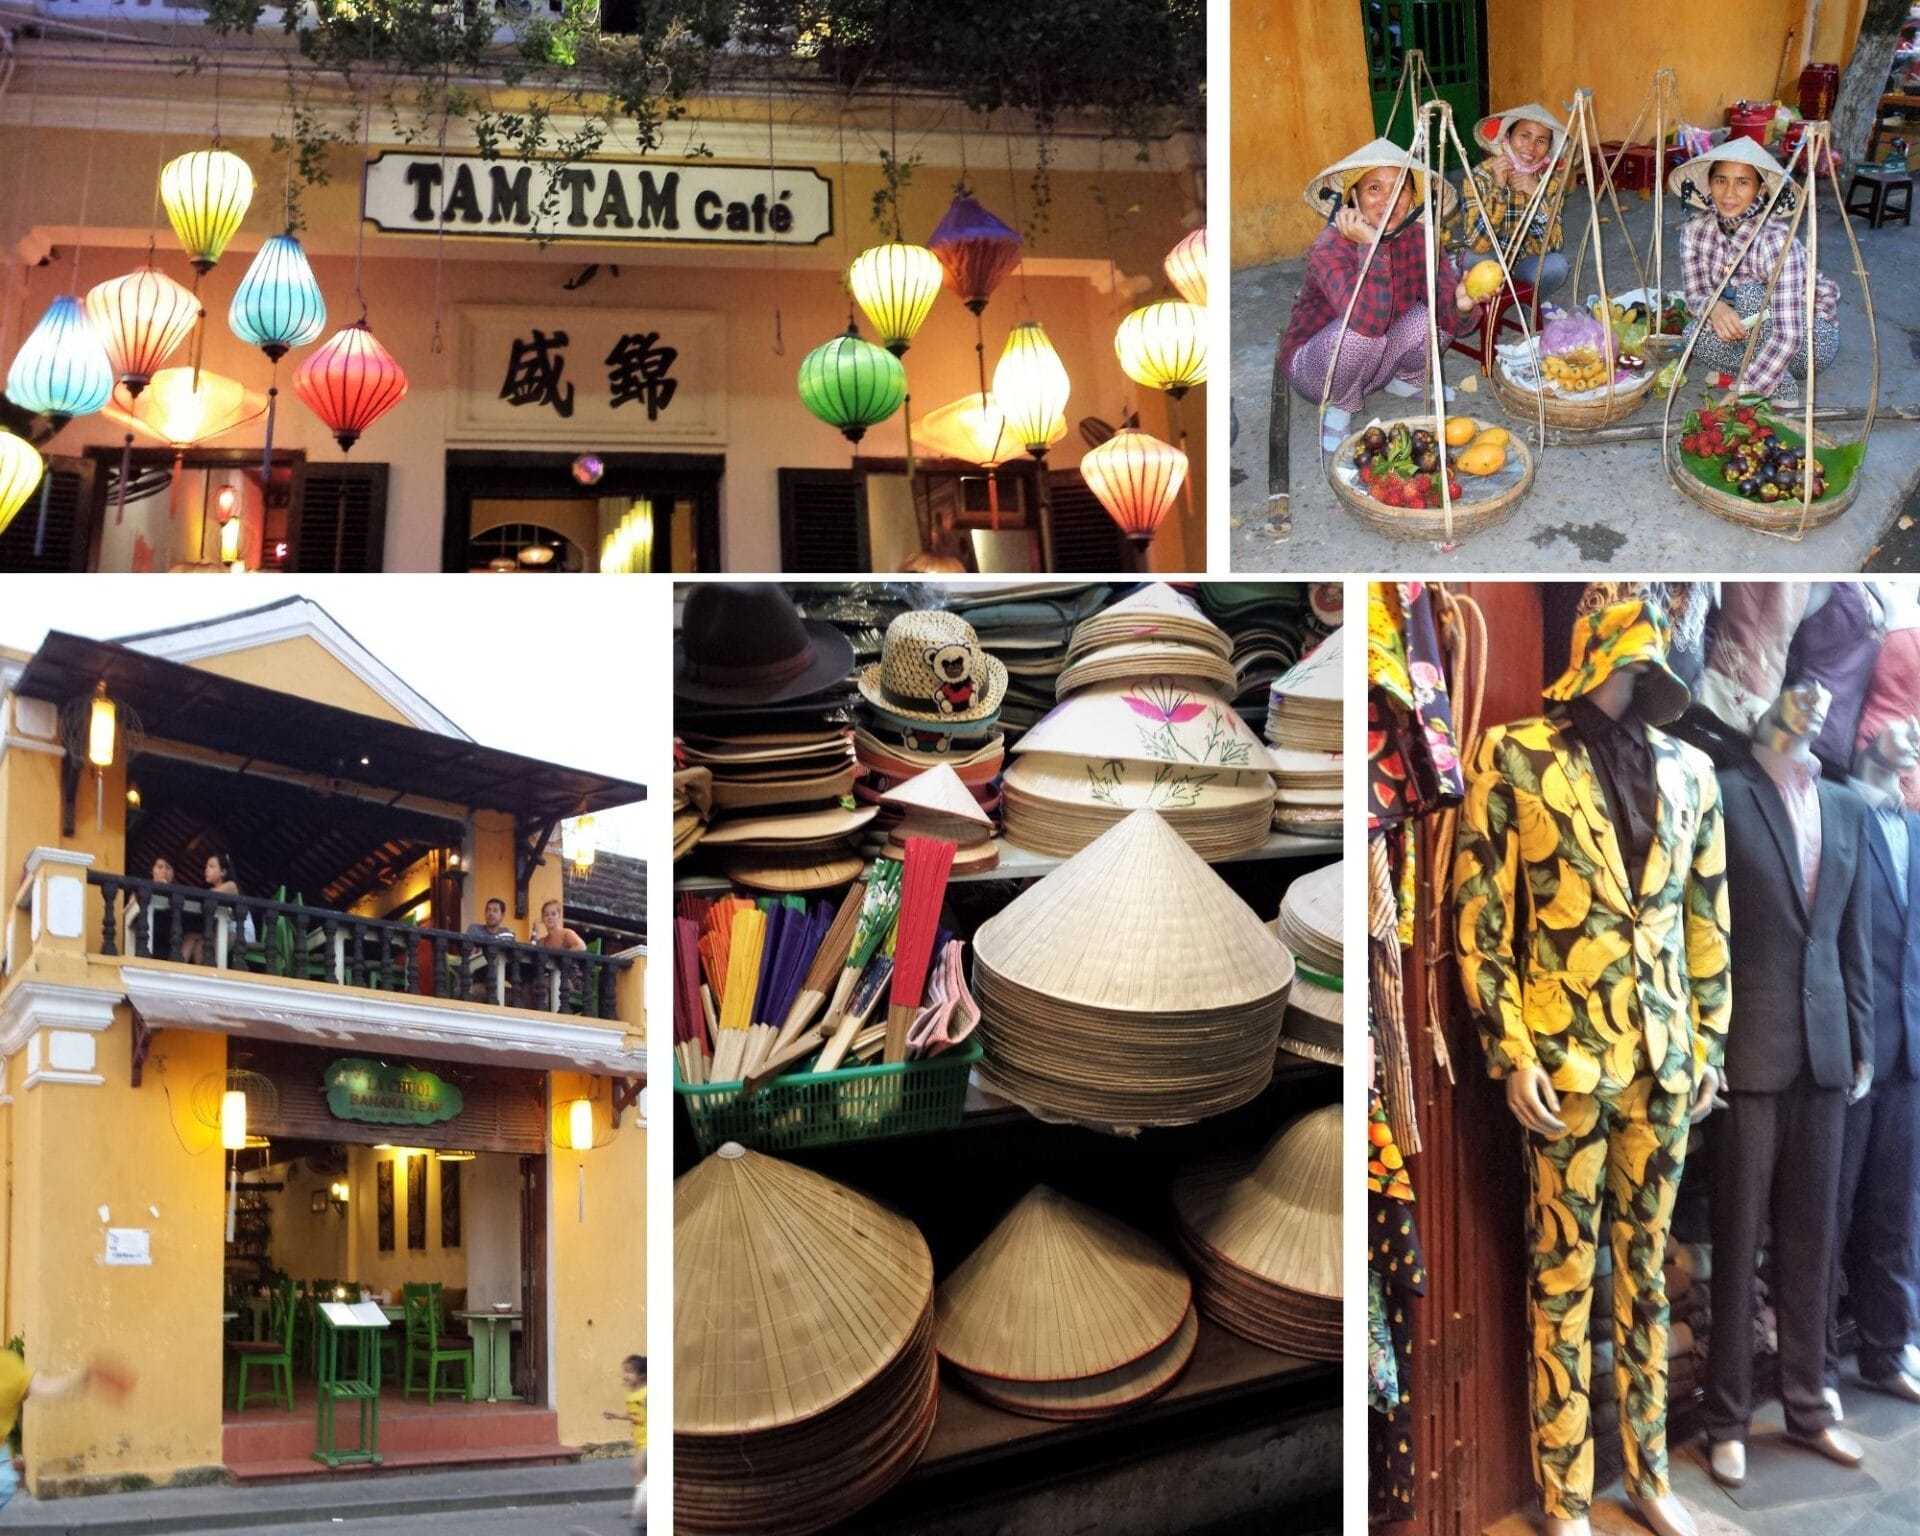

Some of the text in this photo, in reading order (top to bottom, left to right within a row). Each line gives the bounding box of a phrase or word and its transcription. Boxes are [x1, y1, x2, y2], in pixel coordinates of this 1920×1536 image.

[406, 162, 793, 233] TAM TAM Café
